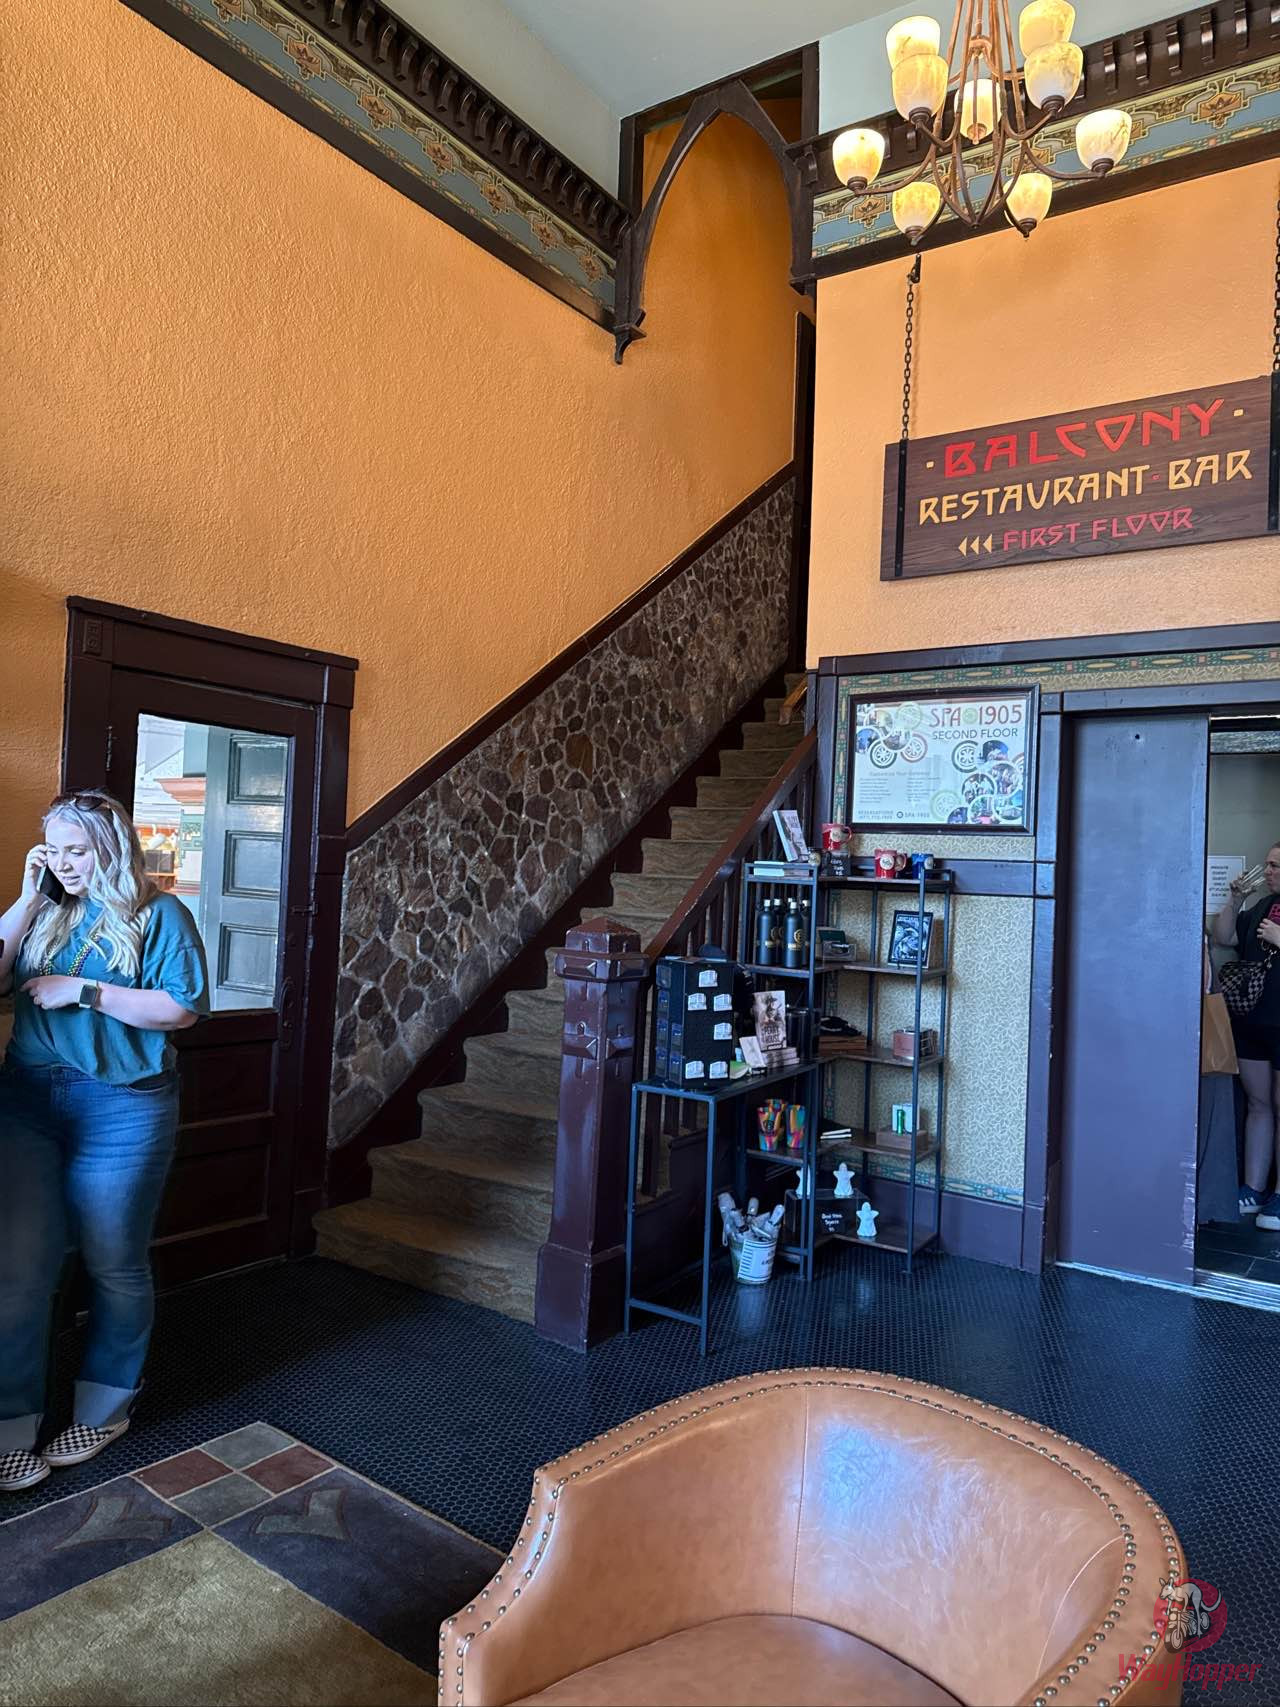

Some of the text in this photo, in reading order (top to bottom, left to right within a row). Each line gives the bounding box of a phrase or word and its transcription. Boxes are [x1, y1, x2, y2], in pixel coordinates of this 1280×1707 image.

[944, 398, 1225, 479] BALCONY
[918, 449, 1253, 526] RESTAURANT BAR
[1002, 507, 1193, 552] FIRST FLOOR
[929, 704, 1022, 728] SPA 1905
[931, 727, 1018, 740] SECOND FLOOR
